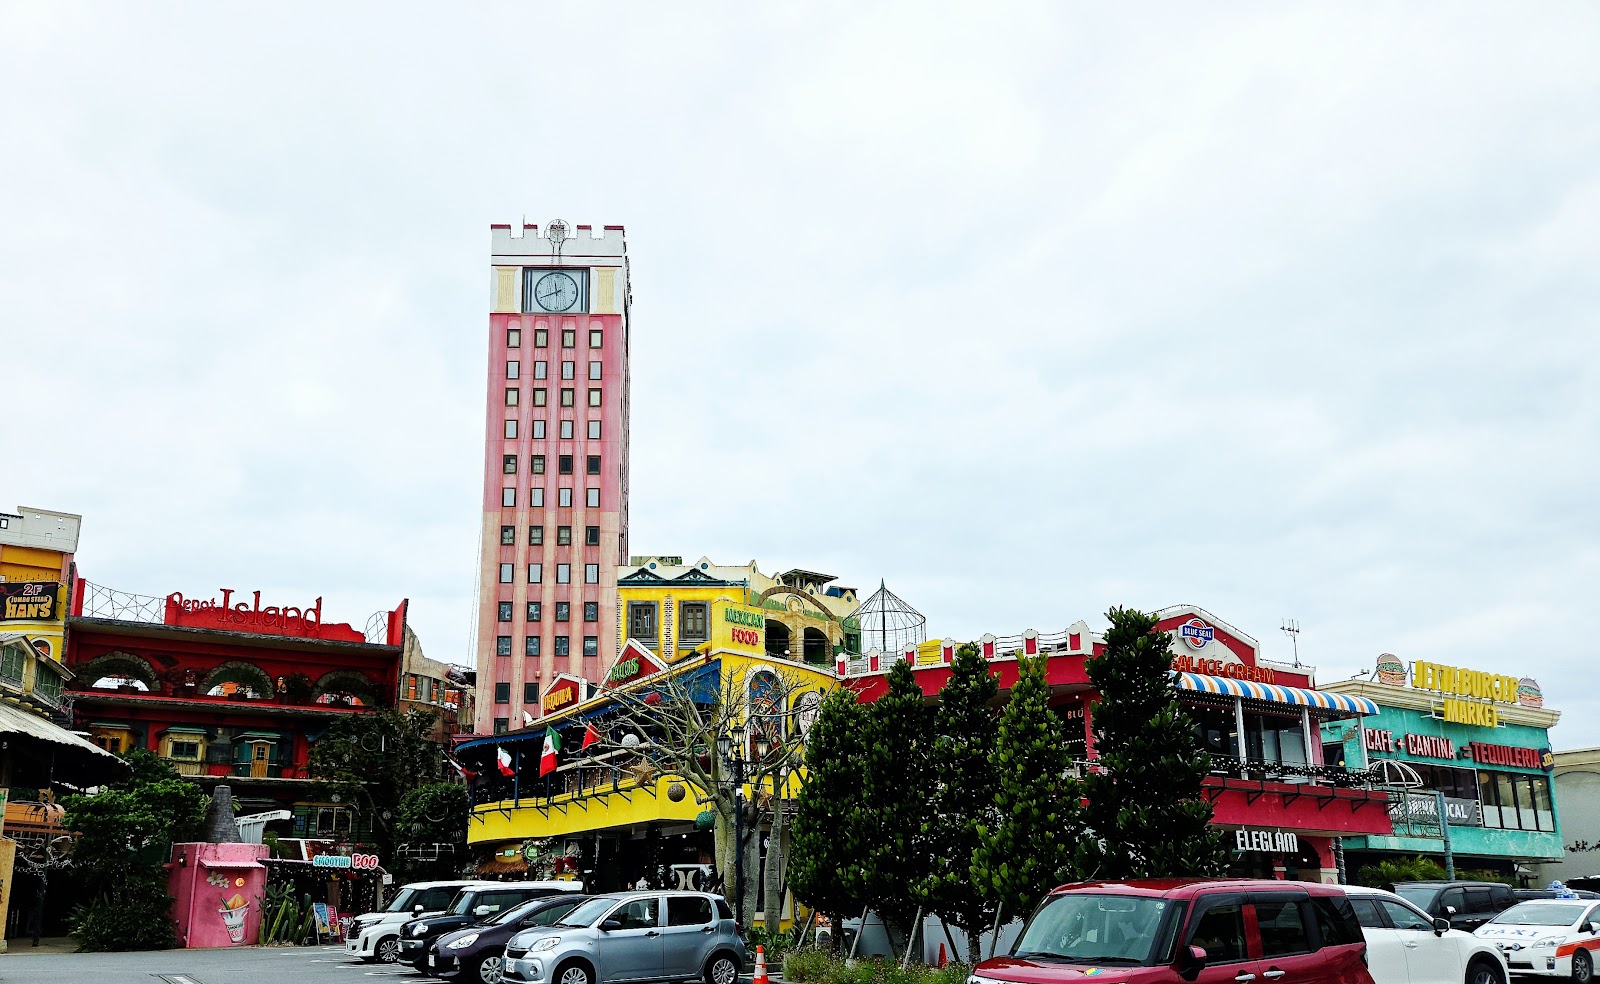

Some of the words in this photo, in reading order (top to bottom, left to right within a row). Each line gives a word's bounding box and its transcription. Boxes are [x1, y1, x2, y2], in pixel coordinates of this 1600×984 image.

[22, 583, 44, 596] 2F
[5, 602, 52, 619] HAN'S
[217, 588, 323, 632] Island
[725, 607, 764, 629] MEXICAN
[731, 627, 759, 646] FOOD
[1184, 626, 1198, 636] BLUE
[1198, 628, 1212, 639] SEAL
[1198, 658, 1224, 677] ICE
[1224, 661, 1276, 685] CREAM
[1443, 699, 1498, 728] MARKET
[1364, 728, 1395, 753] CAFE
[1405, 732, 1456, 760] CANTINA
[1470, 741, 1542, 769] TEQUILERIA
[352, 853, 379, 870] BOO
[1481, 929, 1539, 937] TAXI
